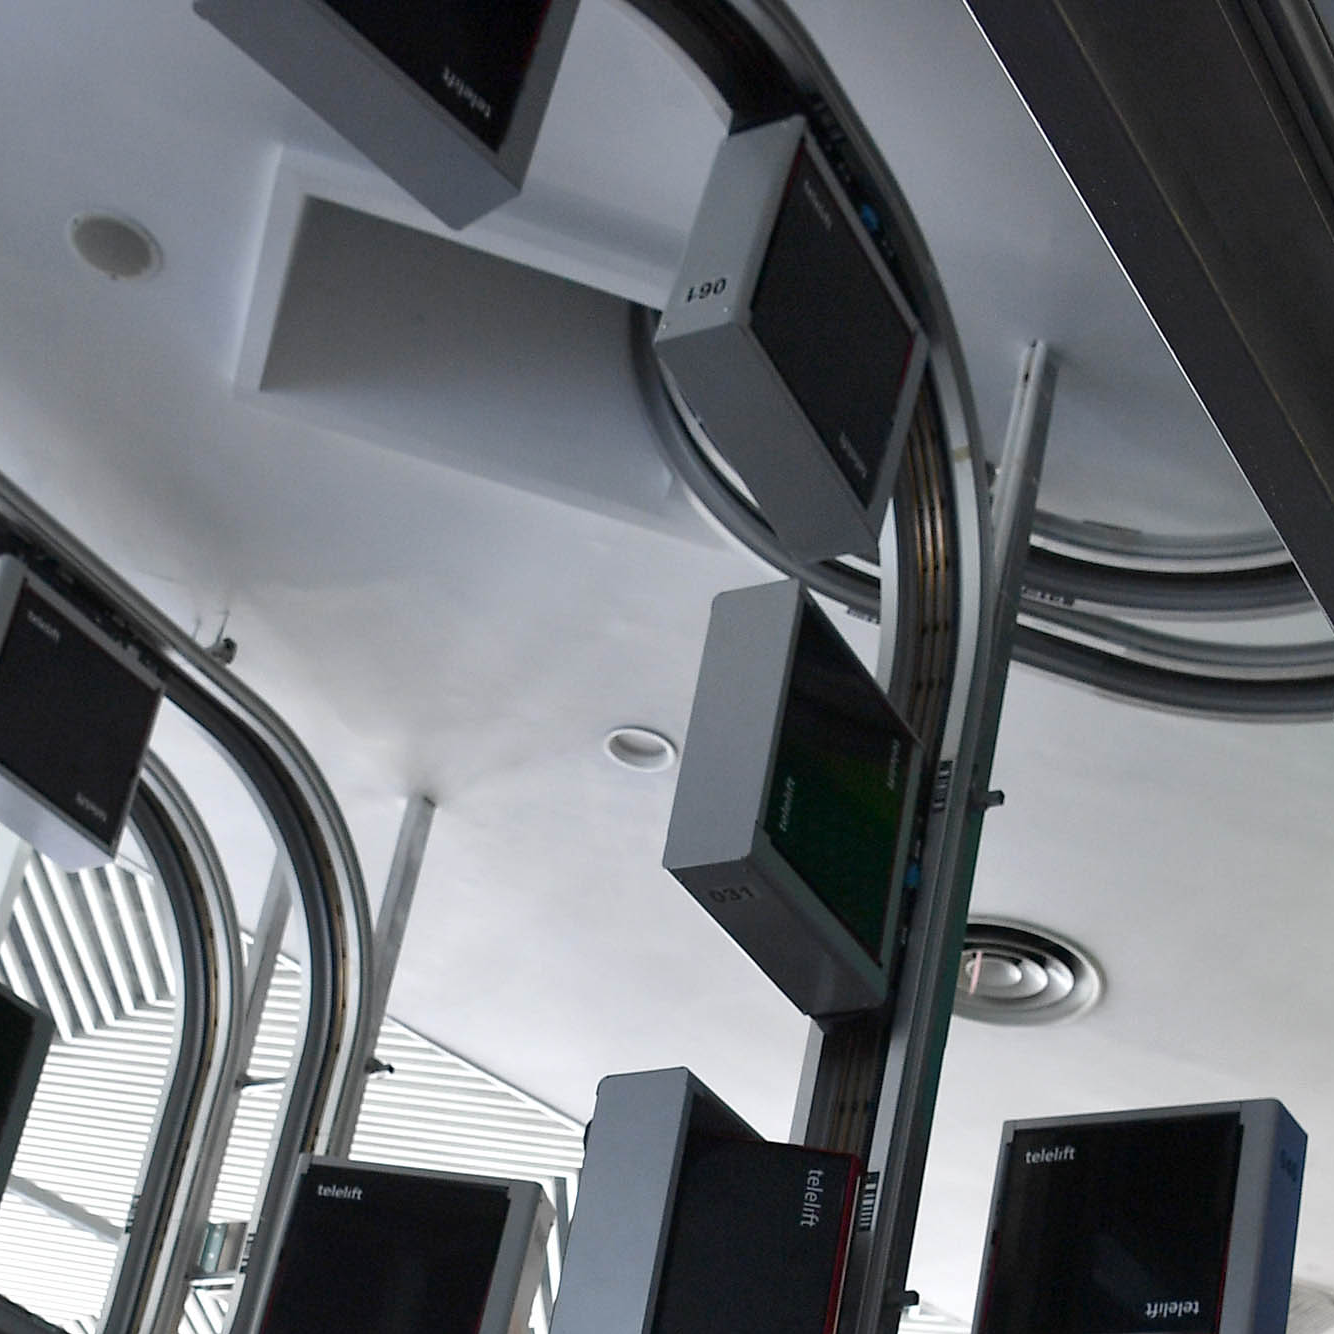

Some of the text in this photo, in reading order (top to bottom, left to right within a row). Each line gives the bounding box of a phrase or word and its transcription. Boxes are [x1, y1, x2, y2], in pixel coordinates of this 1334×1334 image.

[1025, 1145, 1076, 1165] telelift
[316, 1183, 364, 1201] telelift
[799, 1168, 825, 1228] telelift
[1145, 1300, 1200, 1319] telelift
